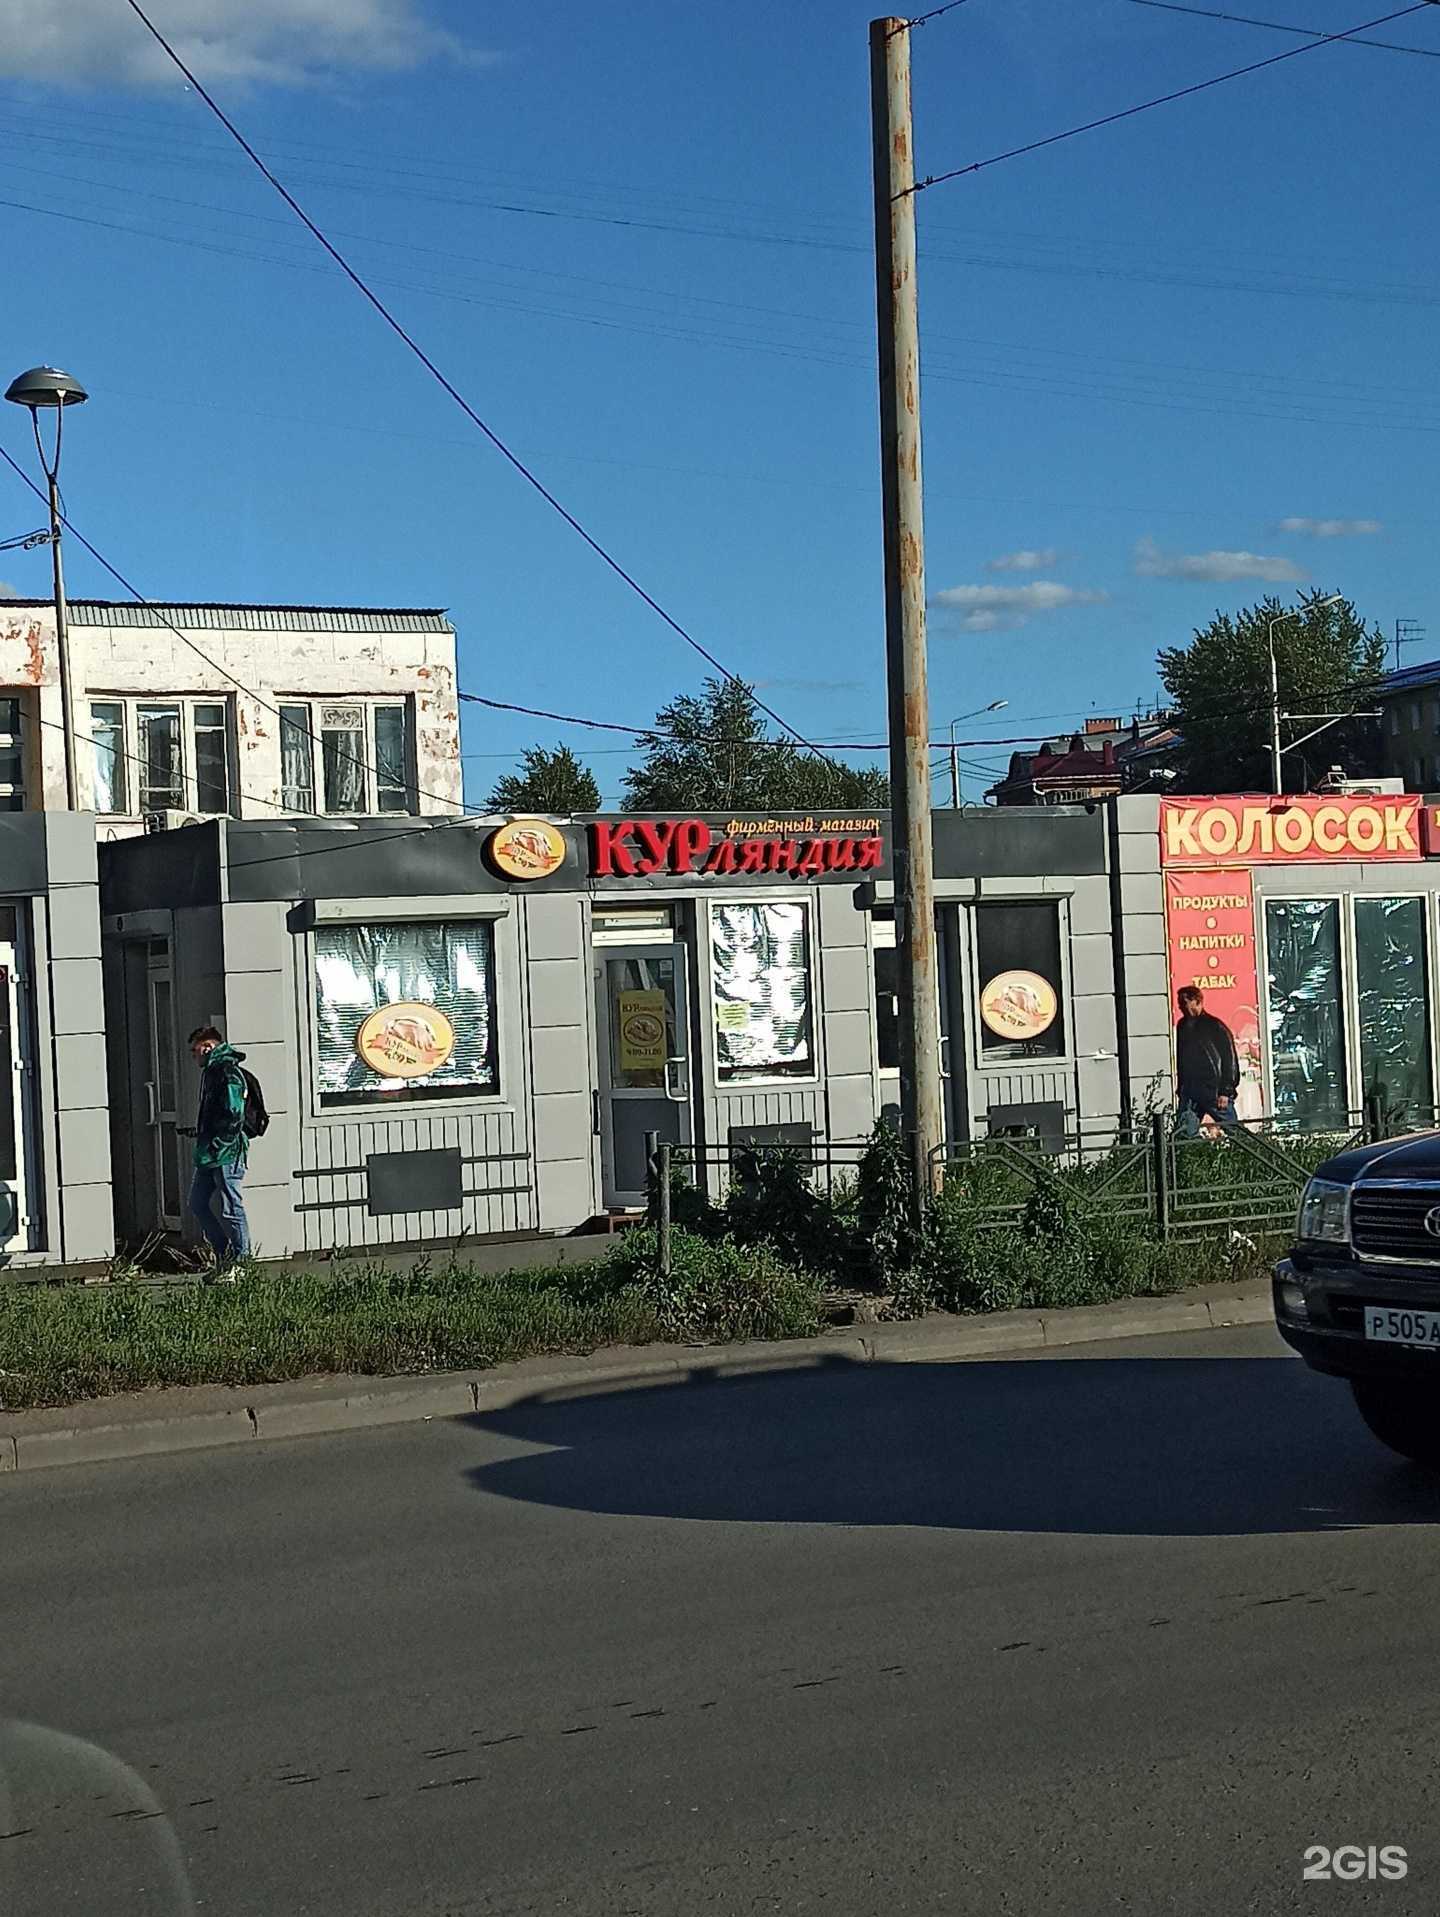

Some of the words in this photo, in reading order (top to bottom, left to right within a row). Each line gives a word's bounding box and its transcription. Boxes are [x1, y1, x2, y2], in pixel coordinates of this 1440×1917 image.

[820, 818, 880, 832] магазин
[1166, 804, 1419, 856] КОЛОСОК
[1173, 895, 1248, 911] ПРОДУКТЫ
[1179, 933, 1245, 951] НАПИТКИ
[1192, 975, 1237, 989] ТАБАК
